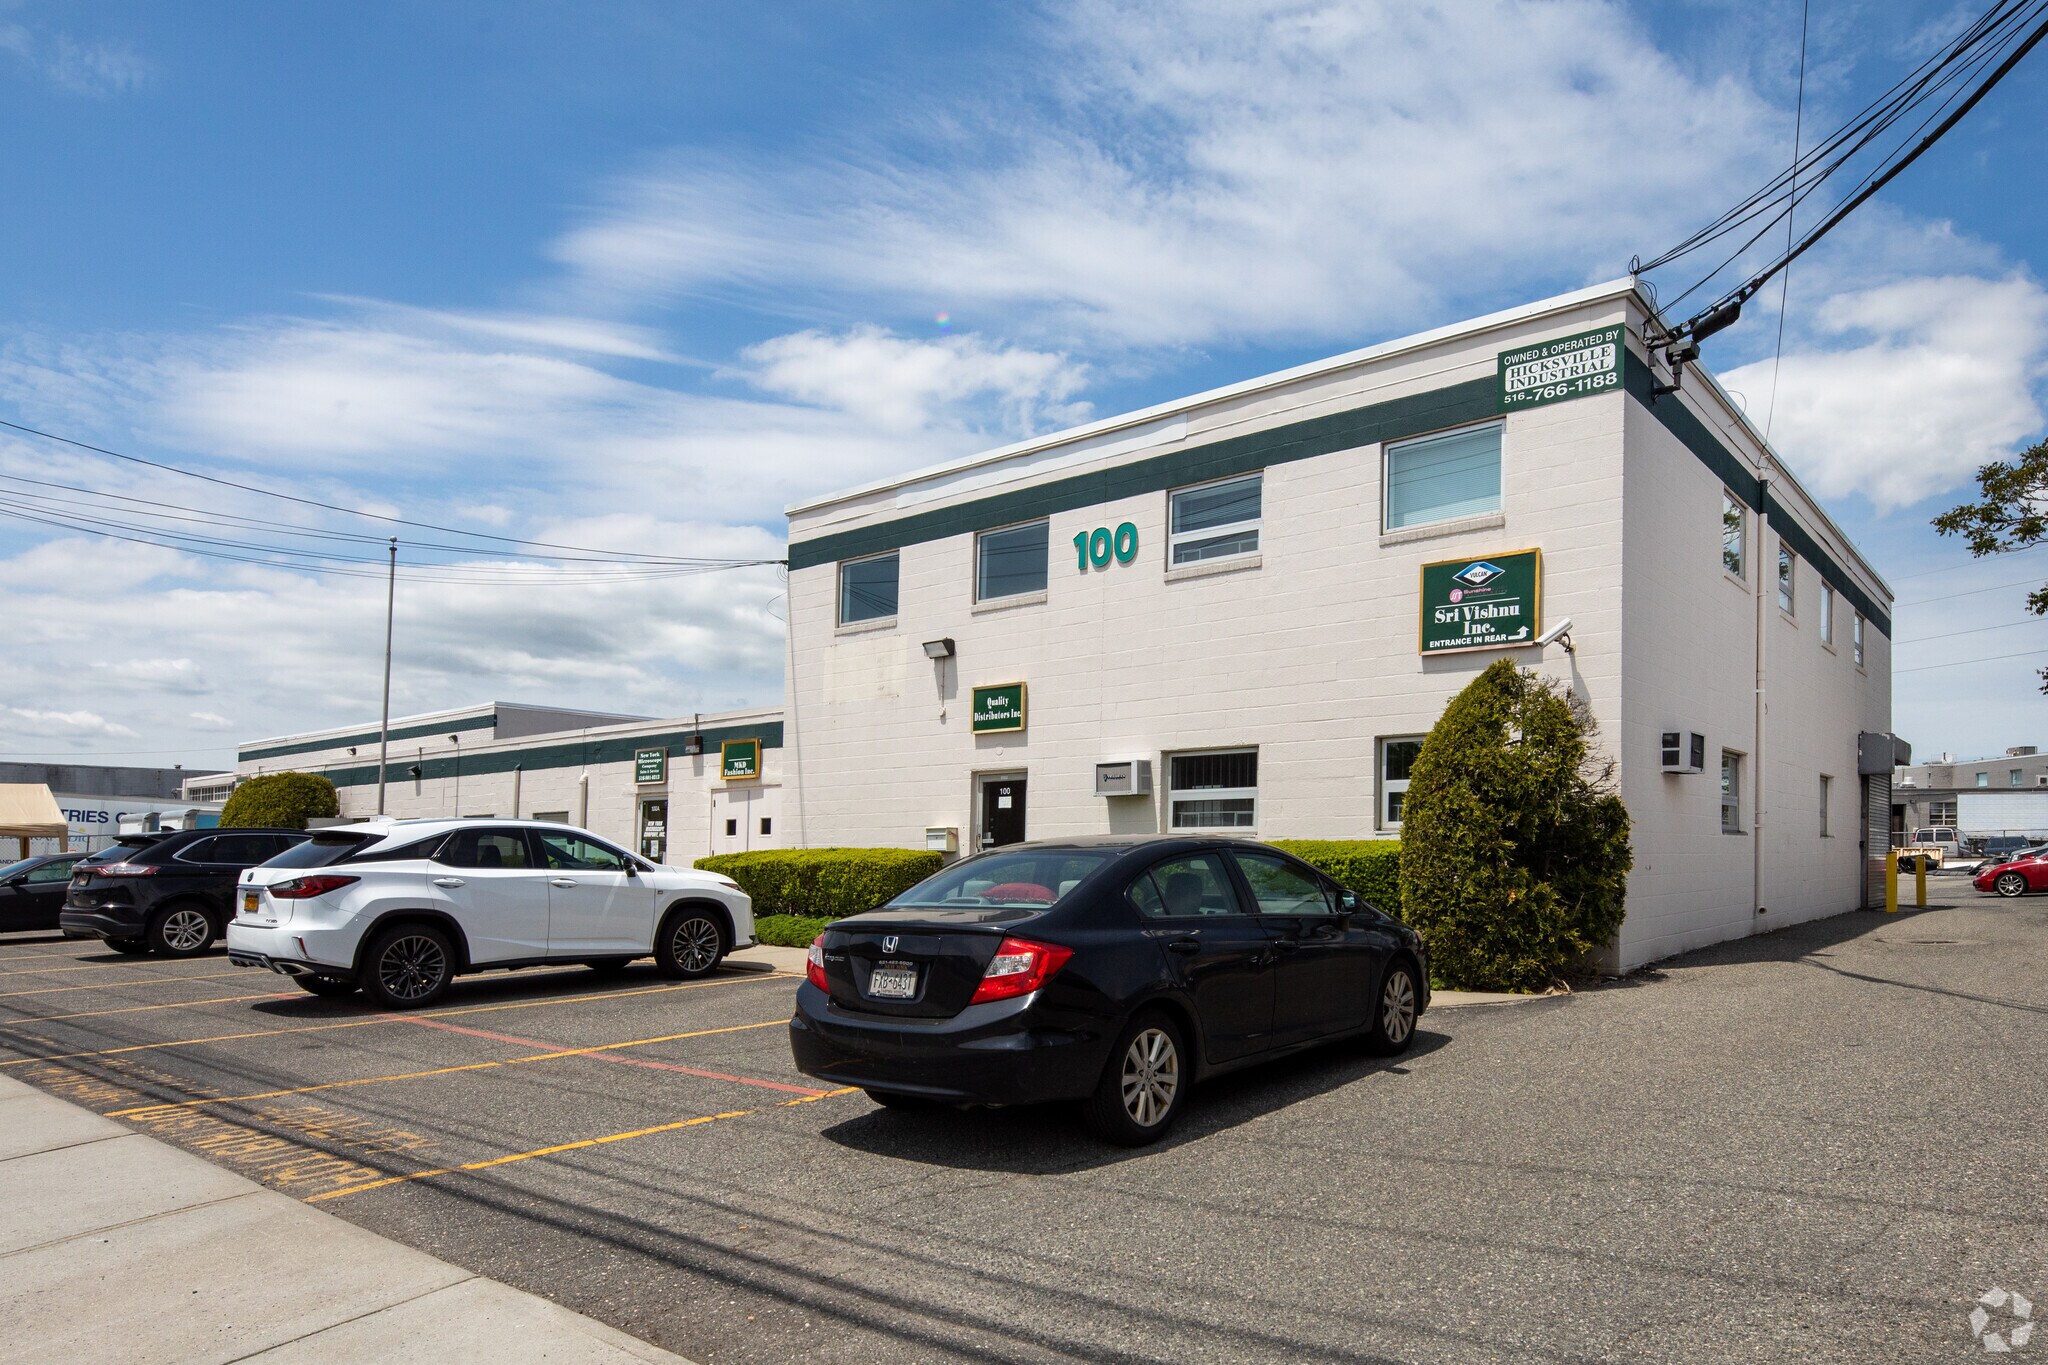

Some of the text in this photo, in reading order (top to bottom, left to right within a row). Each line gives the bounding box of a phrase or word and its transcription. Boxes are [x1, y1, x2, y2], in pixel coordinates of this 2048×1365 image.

[1504, 329, 1619, 365] OWNED & OPERATED BY
[1510, 345, 1611, 378] HICKSVILLE
[1510, 359, 1610, 390] INDUSTRIAL
[1504, 372, 1618, 404] 516-766-1188
[1073, 522, 1138, 570] 100
[1434, 604, 1520, 624] Sri Vishnu
[1463, 620, 1495, 636] Inc.
[1429, 637, 1472, 648] ENTRANCE
[1484, 634, 1507, 642] REAR
[987, 696, 1009, 709] Quality
[974, 711, 1010, 721] Distributors
[724, 768, 744, 776] Fashion
[1000, 787, 1011, 795] 100
